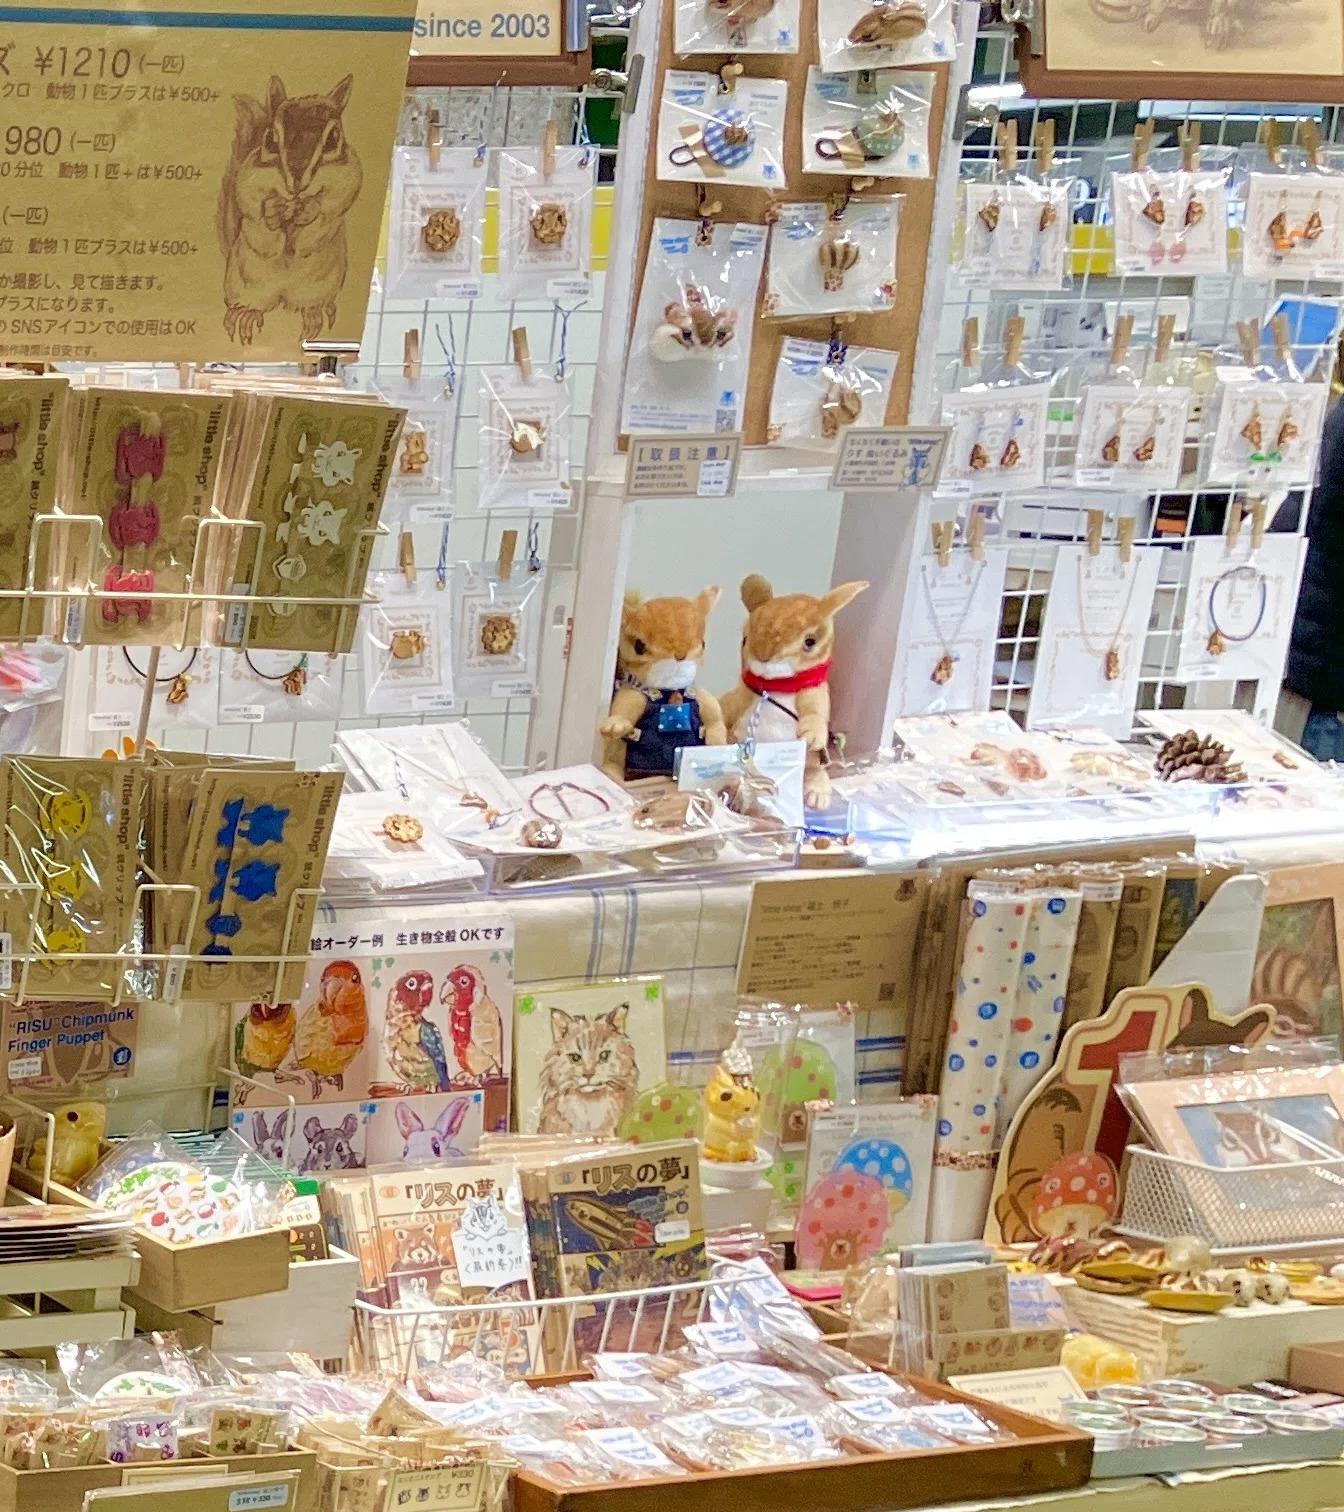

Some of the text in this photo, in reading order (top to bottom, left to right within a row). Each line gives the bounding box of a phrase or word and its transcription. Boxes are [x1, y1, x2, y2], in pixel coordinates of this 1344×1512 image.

[414, 12, 550, 38] since 2003
[62, 1008, 134, 1029] Chipmunk
[8, 1030, 105, 1053] Finger Puppet
